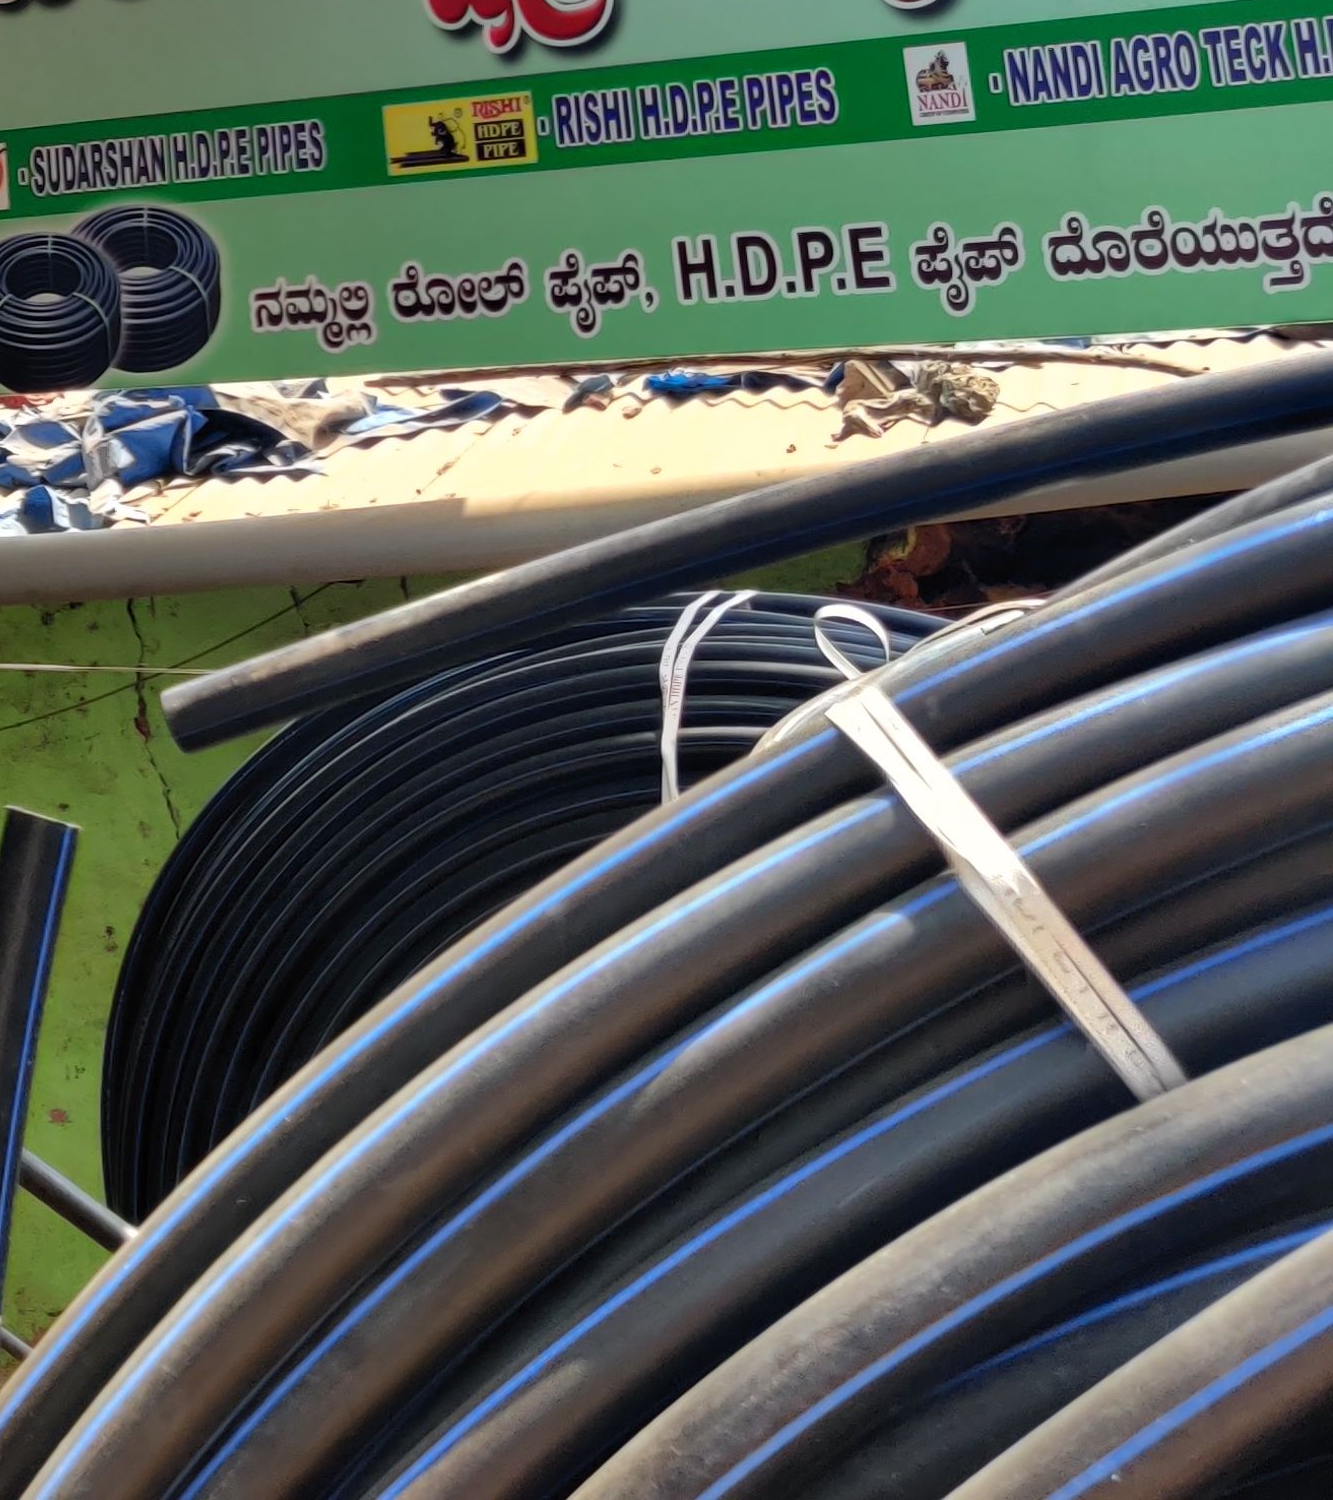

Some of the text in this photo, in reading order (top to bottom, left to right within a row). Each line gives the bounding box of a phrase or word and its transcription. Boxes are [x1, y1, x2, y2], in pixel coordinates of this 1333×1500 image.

[1003, 40, 1106, 107] NANDI
[1110, 32, 1201, 99] AGRO
[1199, 20, 1294, 88] TECK
[470, 97, 523, 118] RISHI
[552, 86, 634, 148] RISHI
[743, 67, 840, 130] PIPES
[917, 88, 968, 112] NANDI
[477, 122, 521, 139] HDPE
[483, 142, 519, 158] PIPE
[32, 135, 167, 197] SUDARSHAN
[254, 118, 324, 174] PIPES
[252, 276, 376, 352] ನಮ್ಮಲ್ಲಿ
[391, 259, 528, 321] ರೋಲ್
[673, 224, 893, 303] H.D.P.E
[912, 224, 1023, 315] ಪೈಪ್
